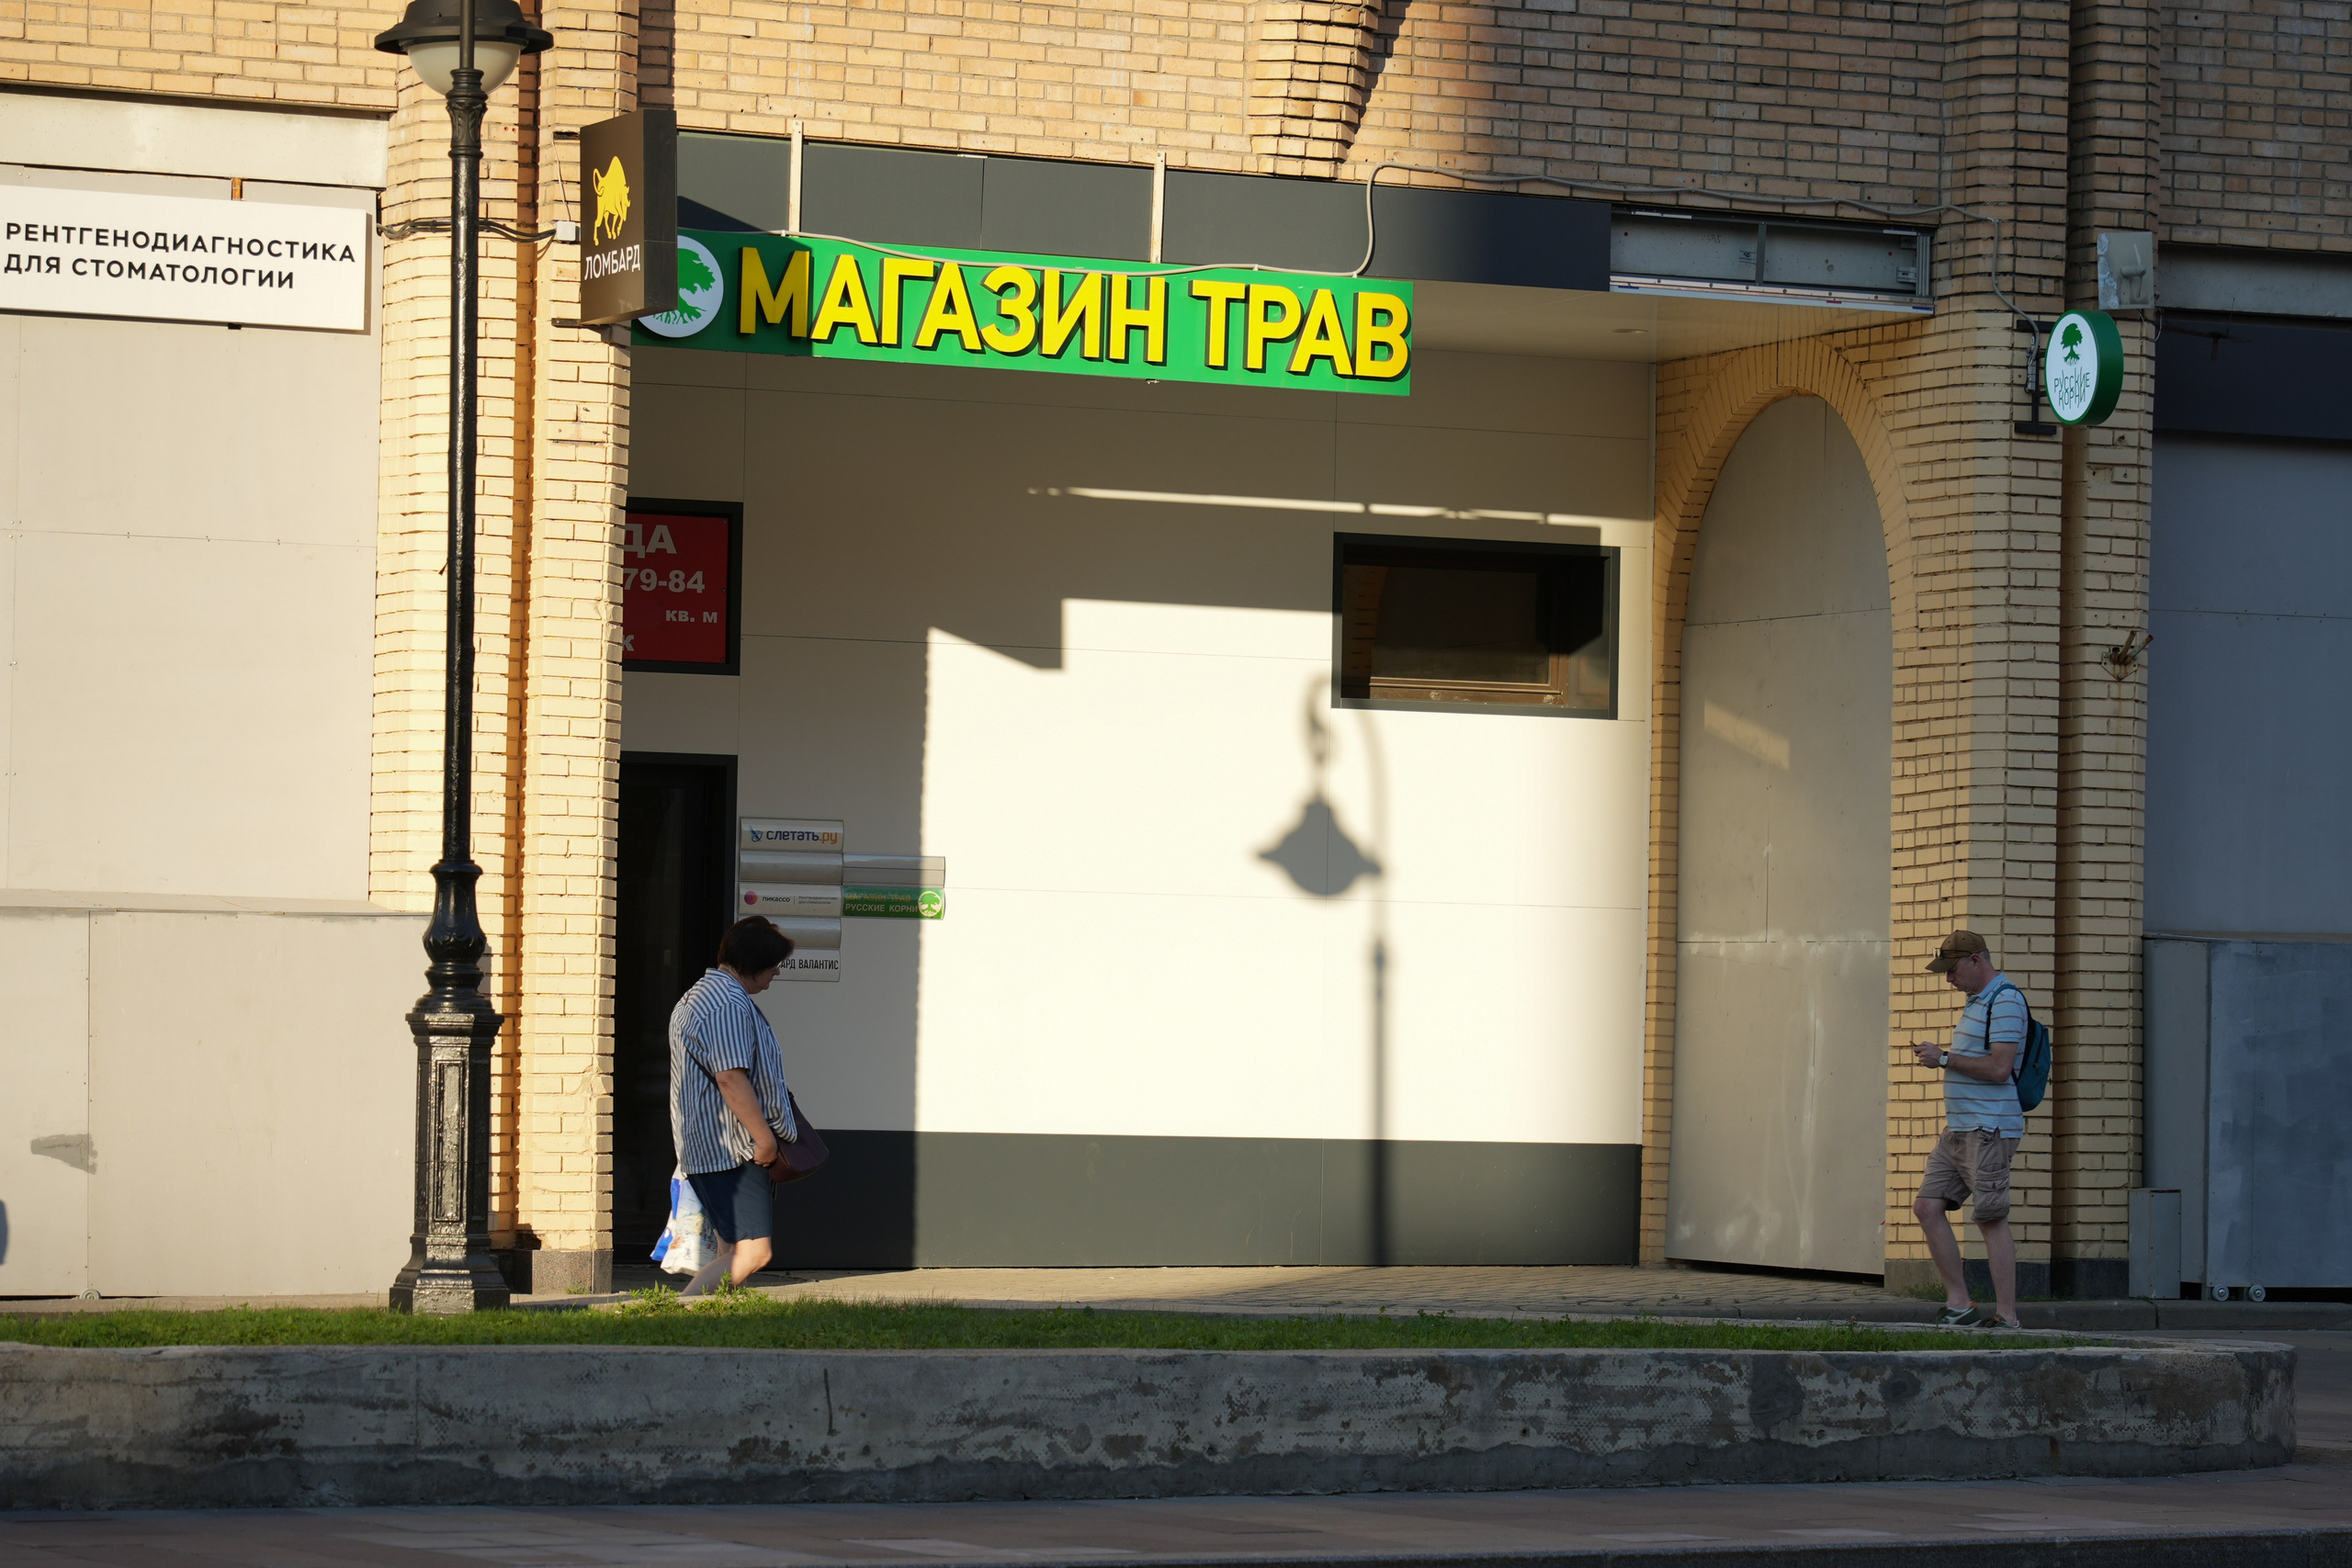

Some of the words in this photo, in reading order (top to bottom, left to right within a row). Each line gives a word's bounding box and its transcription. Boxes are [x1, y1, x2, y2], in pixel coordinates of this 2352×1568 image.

[6, 222, 356, 263] РЕНТГЕНОДИАГНОСТИКА
[4, 254, 61, 275] ДЛЯ
[72, 257, 294, 289] СТОМАТОЛОГИИ
[583, 243, 640, 281] ЛОМБАРД
[738, 246, 1169, 363] МАГАЗИН
[1190, 279, 1411, 379] ТРАВ
[2053, 367, 2090, 393] РУССКИЕ
[2058, 387, 2086, 411] КОРНИ
[766, 830, 838, 844] слетать.ру
[845, 893, 887, 901] МАГАЗИН
[890, 894, 911, 902] ТРАВ
[845, 903, 885, 912] РУССКИЕ
[888, 904, 918, 913] КОРНИ
[778, 959, 796, 970] АРД
[798, 959, 839, 970] ВАЛАНТИС
